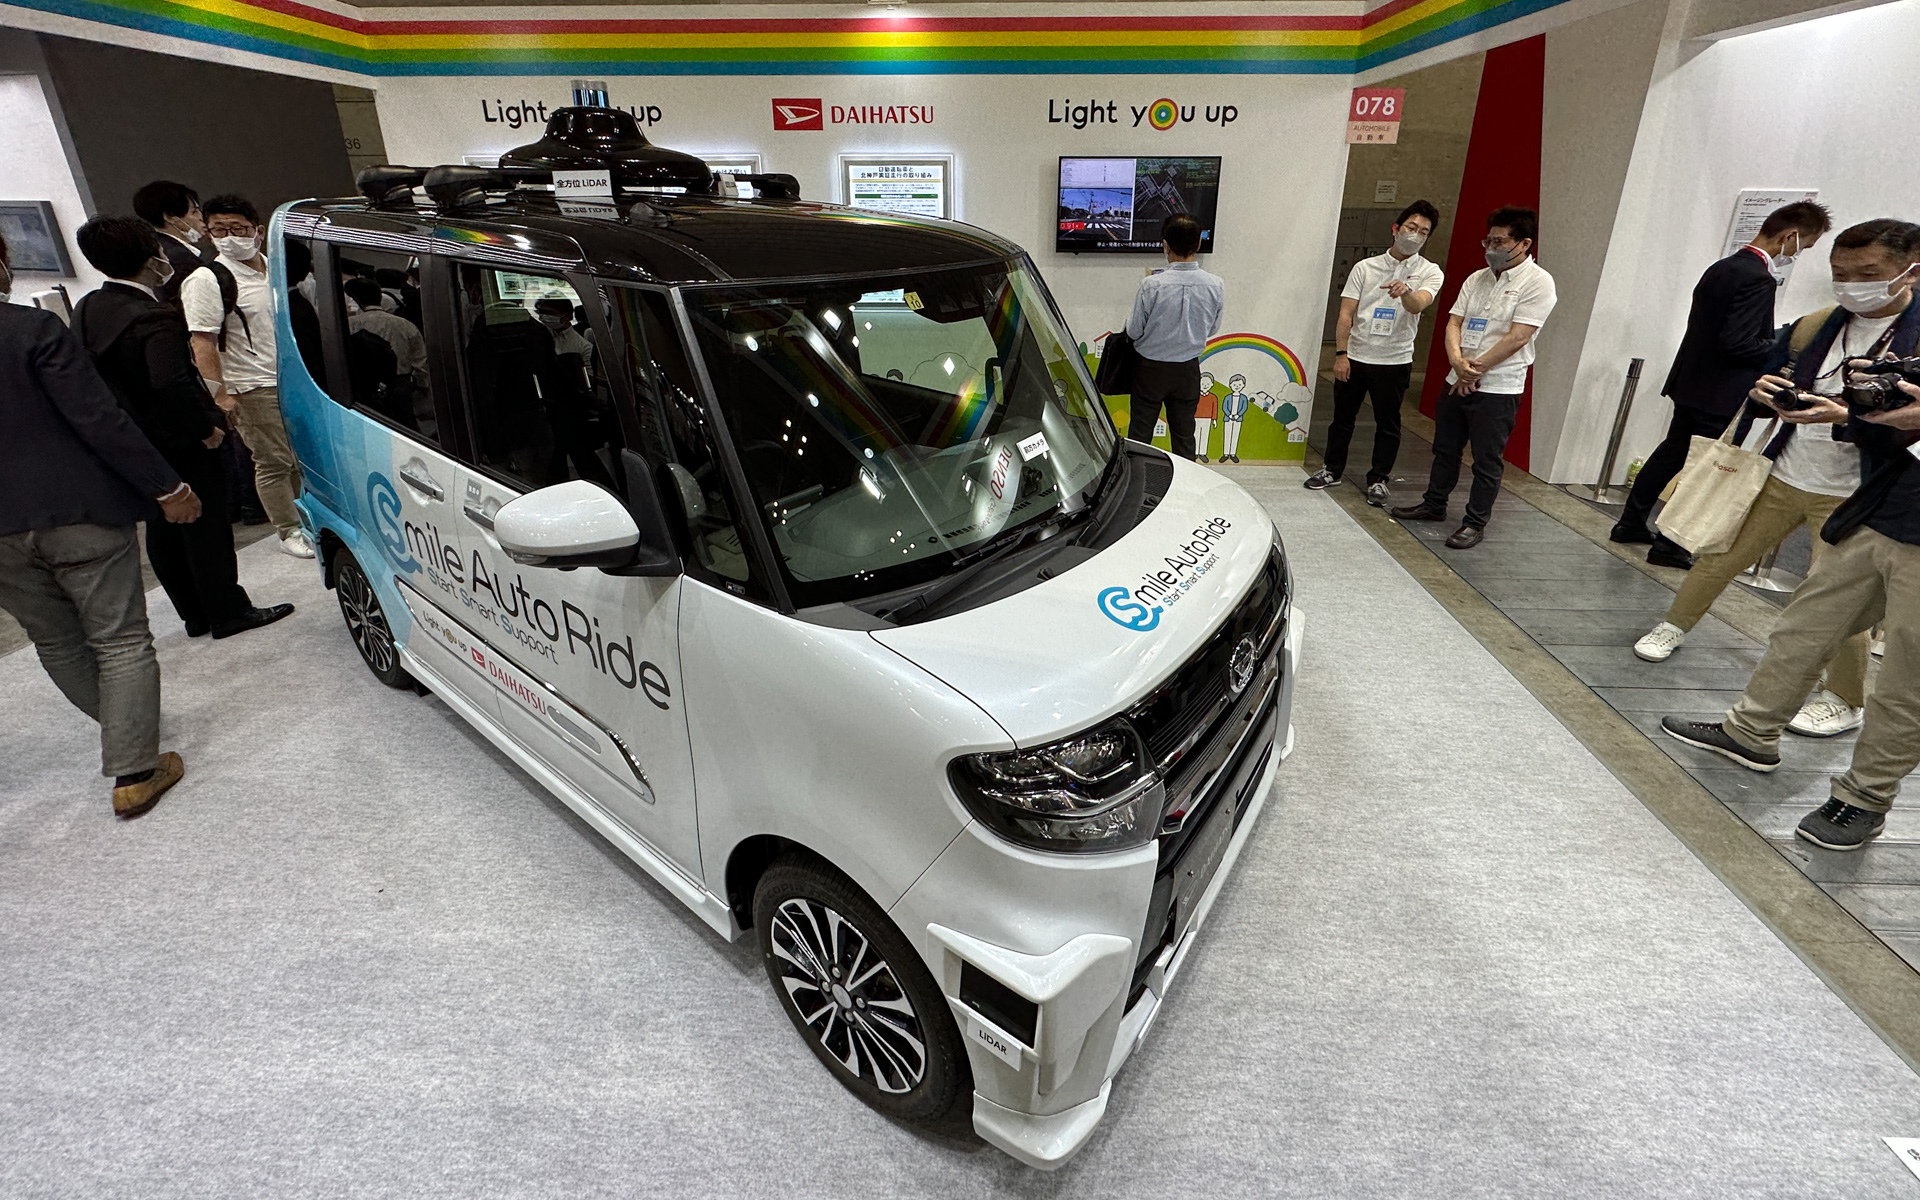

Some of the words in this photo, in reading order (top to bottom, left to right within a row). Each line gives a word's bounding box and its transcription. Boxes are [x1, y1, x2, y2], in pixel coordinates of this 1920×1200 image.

[482, 98, 548, 130] Light
[630, 104, 662, 127] up
[831, 104, 935, 125] DAIHATSU
[1048, 98, 1118, 130] Light
[1205, 103, 1239, 128] up
[1355, 96, 1396, 116] 078
[1353, 124, 1391, 132] AUTOMOBILE
[556, 178, 580, 188] 全方位
[582, 178, 608, 188] LiDAR
[911, 299, 922, 309] 10
[1162, 588, 1185, 607] Start
[1179, 571, 1202, 591] Smart
[1195, 553, 1220, 575] Support
[428, 566, 459, 600] Start
[459, 587, 500, 627] Smart
[500, 613, 559, 665] Support
[488, 660, 547, 716] DAIHATSU
[979, 1029, 1008, 1056] LiDAR
